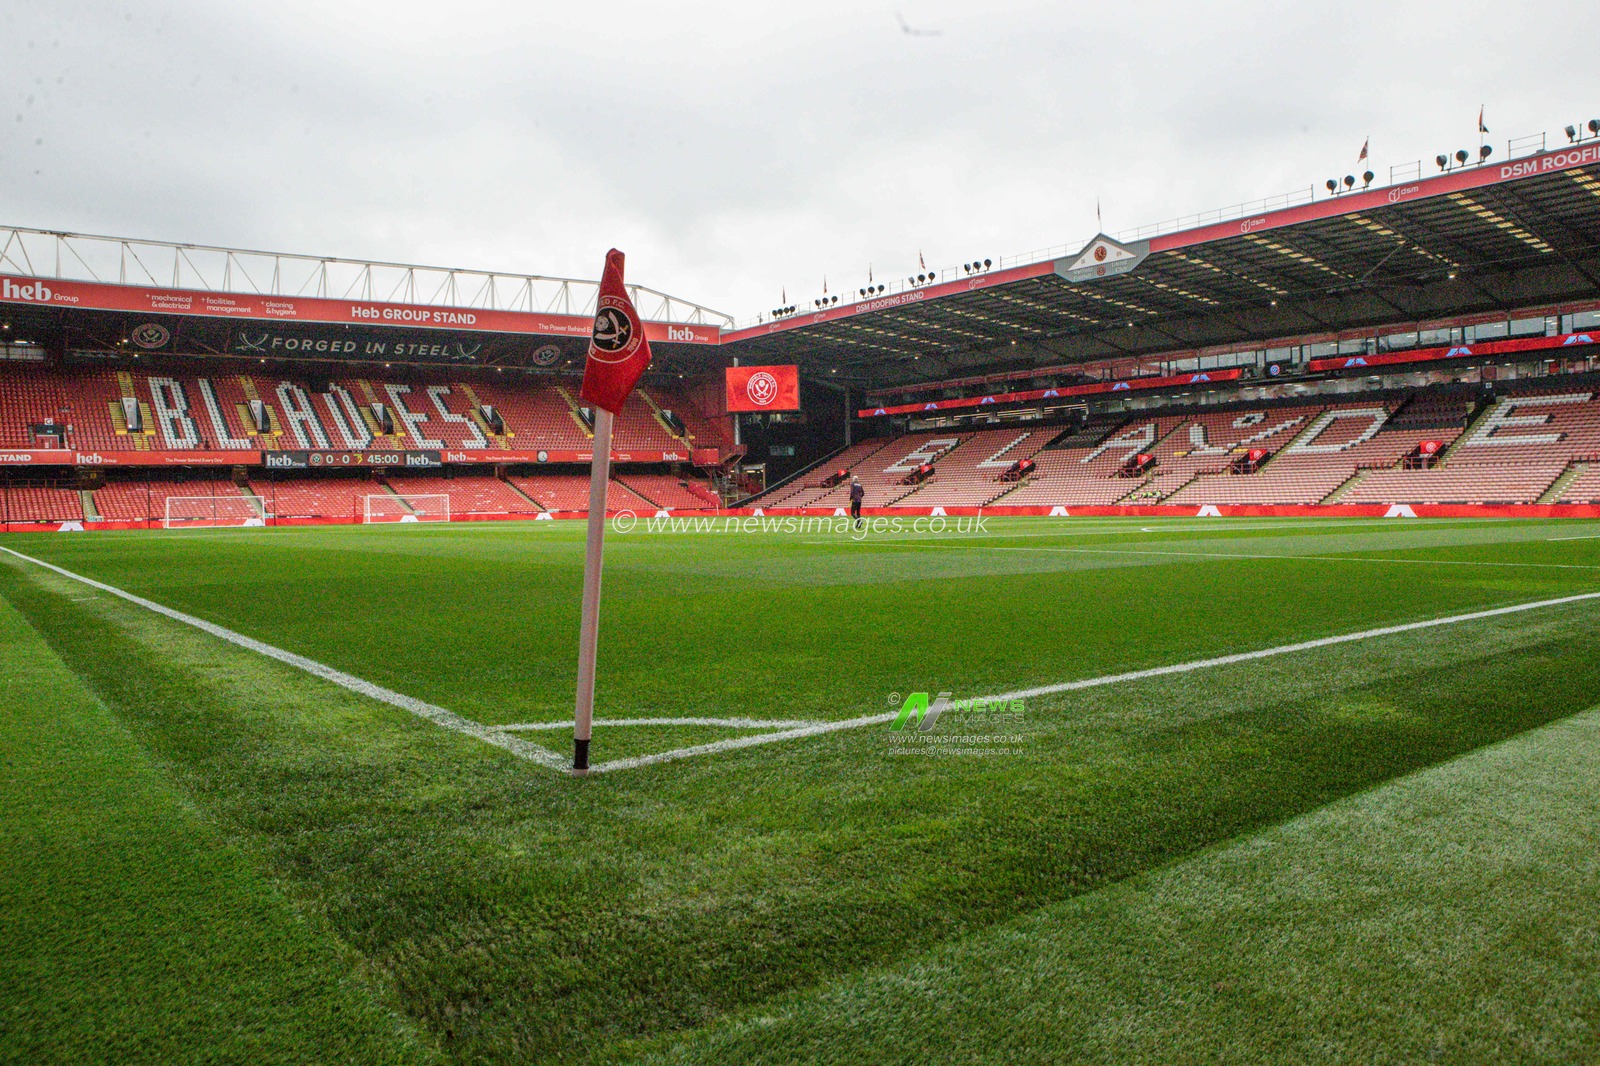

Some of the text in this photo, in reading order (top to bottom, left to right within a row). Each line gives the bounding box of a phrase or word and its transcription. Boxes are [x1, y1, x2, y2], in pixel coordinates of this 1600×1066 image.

[1500, 146, 1600, 179] DSM ROOFI
[1400, 185, 1419, 196] dsm
[1250, 217, 1266, 226] dsm
[3, 278, 79, 304] heb Group
[151, 294, 192, 303] mechanical
[206, 297, 236, 306] facilities
[856, 291, 924, 313] DSM ROOFING STAND
[206, 304, 252, 314] management
[265, 301, 294, 310] cleaning
[351, 306, 477, 325] Heb GROUP STAND
[567, 325, 587, 333] Behind
[668, 325, 694, 342] heb
[271, 337, 450, 356] FORGED IN STEEL
[146, 376, 490, 451] BLADES
[76, 452, 102, 464] heb
[266, 454, 292, 466] heb
[326, 454, 334, 464] 0
[342, 454, 350, 464] 0
[367, 454, 399, 464] 45:00
[406, 454, 430, 466] heb
[447, 452, 467, 462] heb
[663, 452, 678, 461] heb
